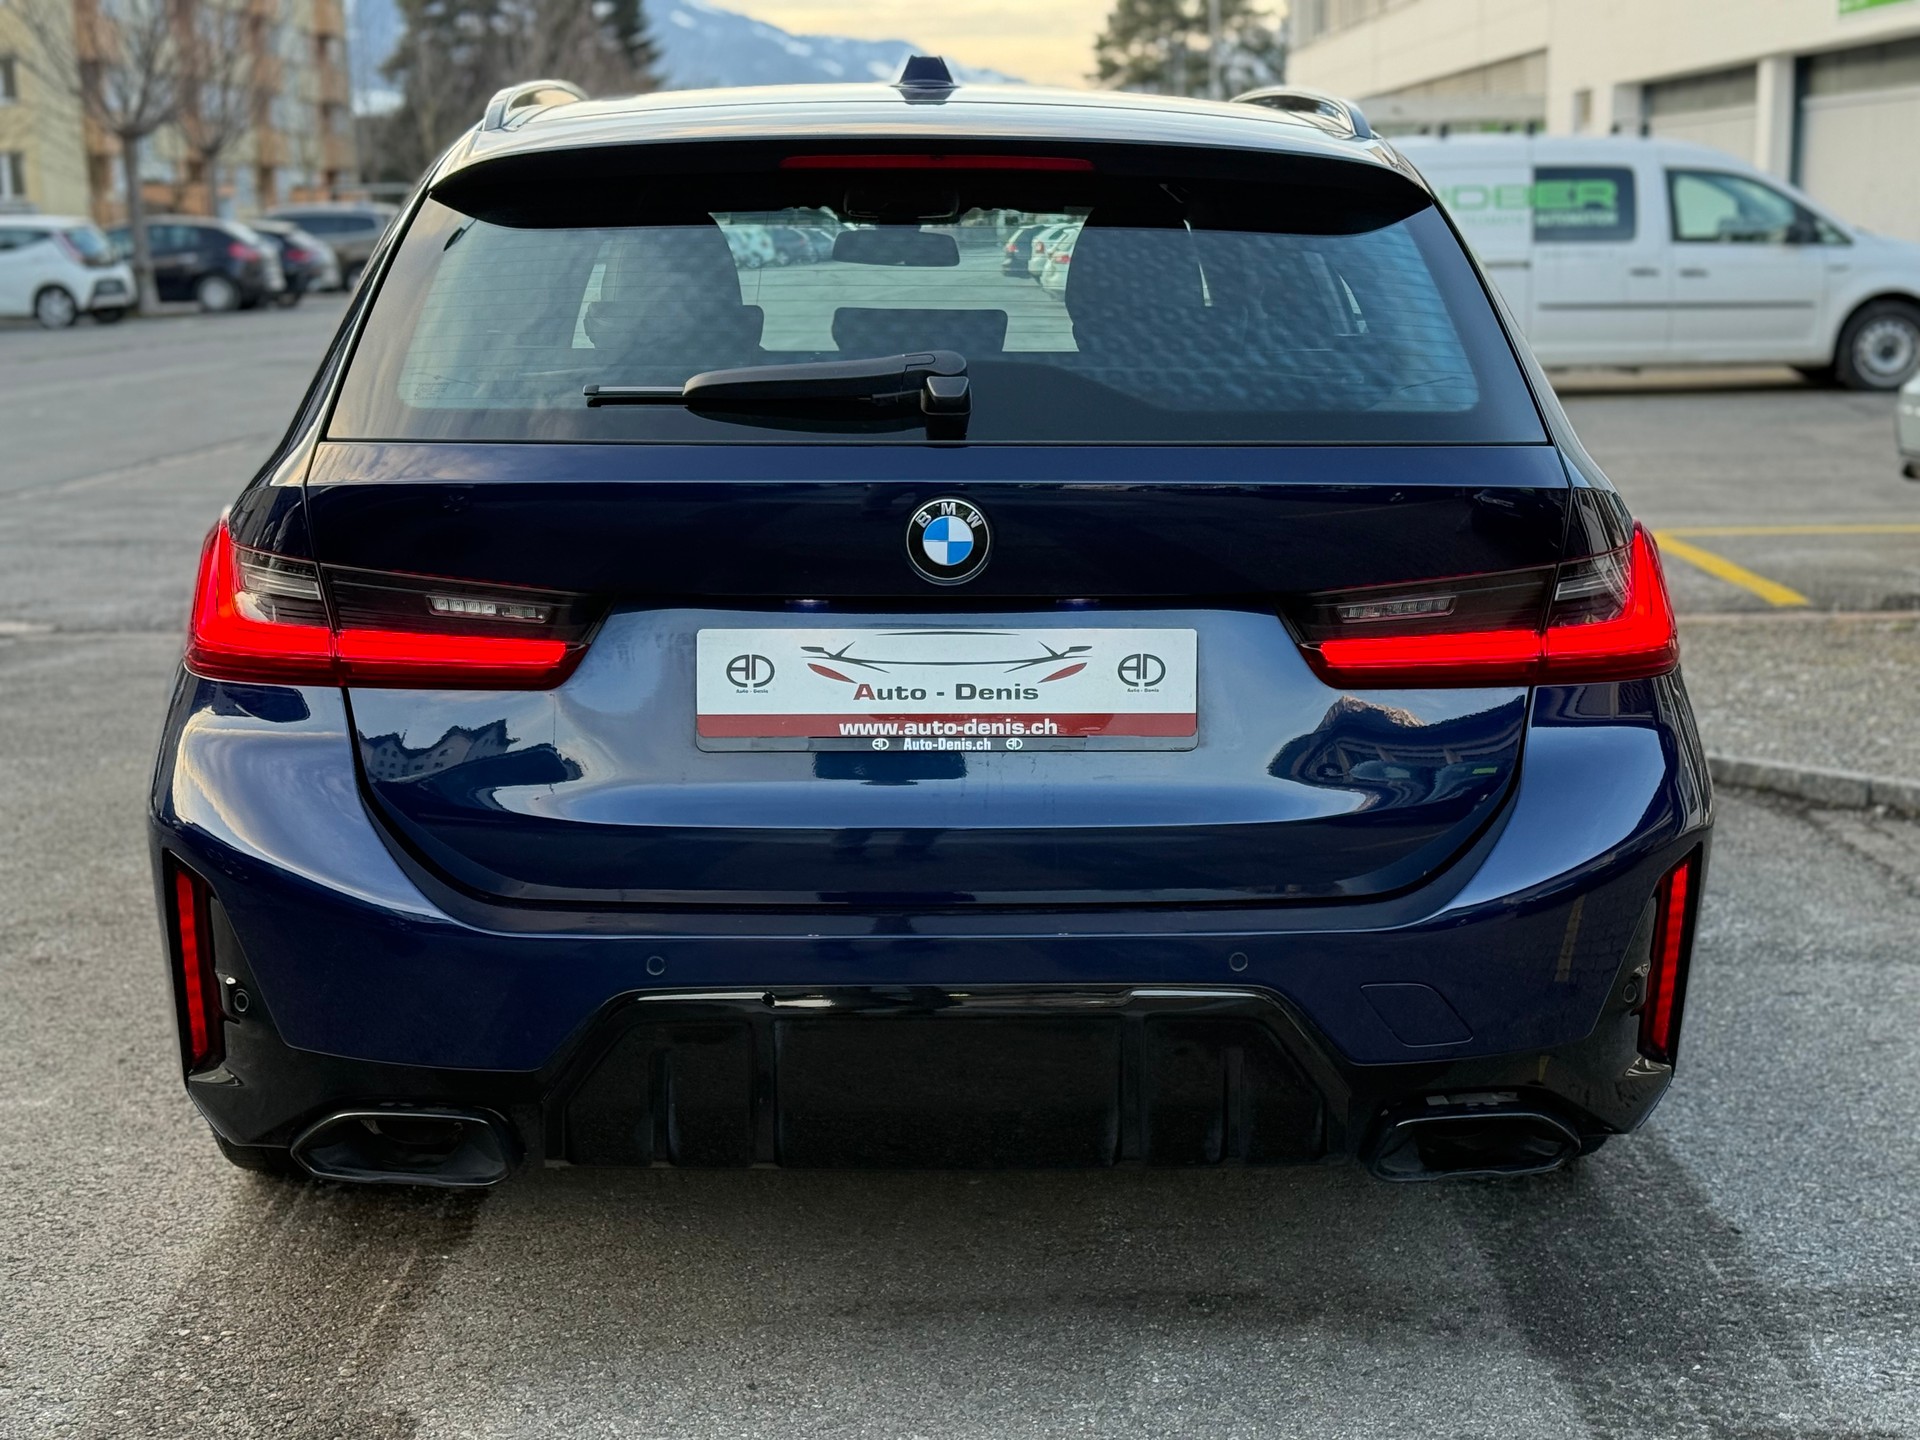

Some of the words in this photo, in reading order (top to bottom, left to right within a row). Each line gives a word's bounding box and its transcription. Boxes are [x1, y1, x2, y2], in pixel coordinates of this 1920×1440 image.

[915, 502, 983, 529] BMW
[853, 683, 927, 701] Auto
[955, 683, 1039, 701] Denis
[839, 718, 1058, 736] www.auto-denis.ch
[903, 738, 992, 750] Auto-Denis.ch
